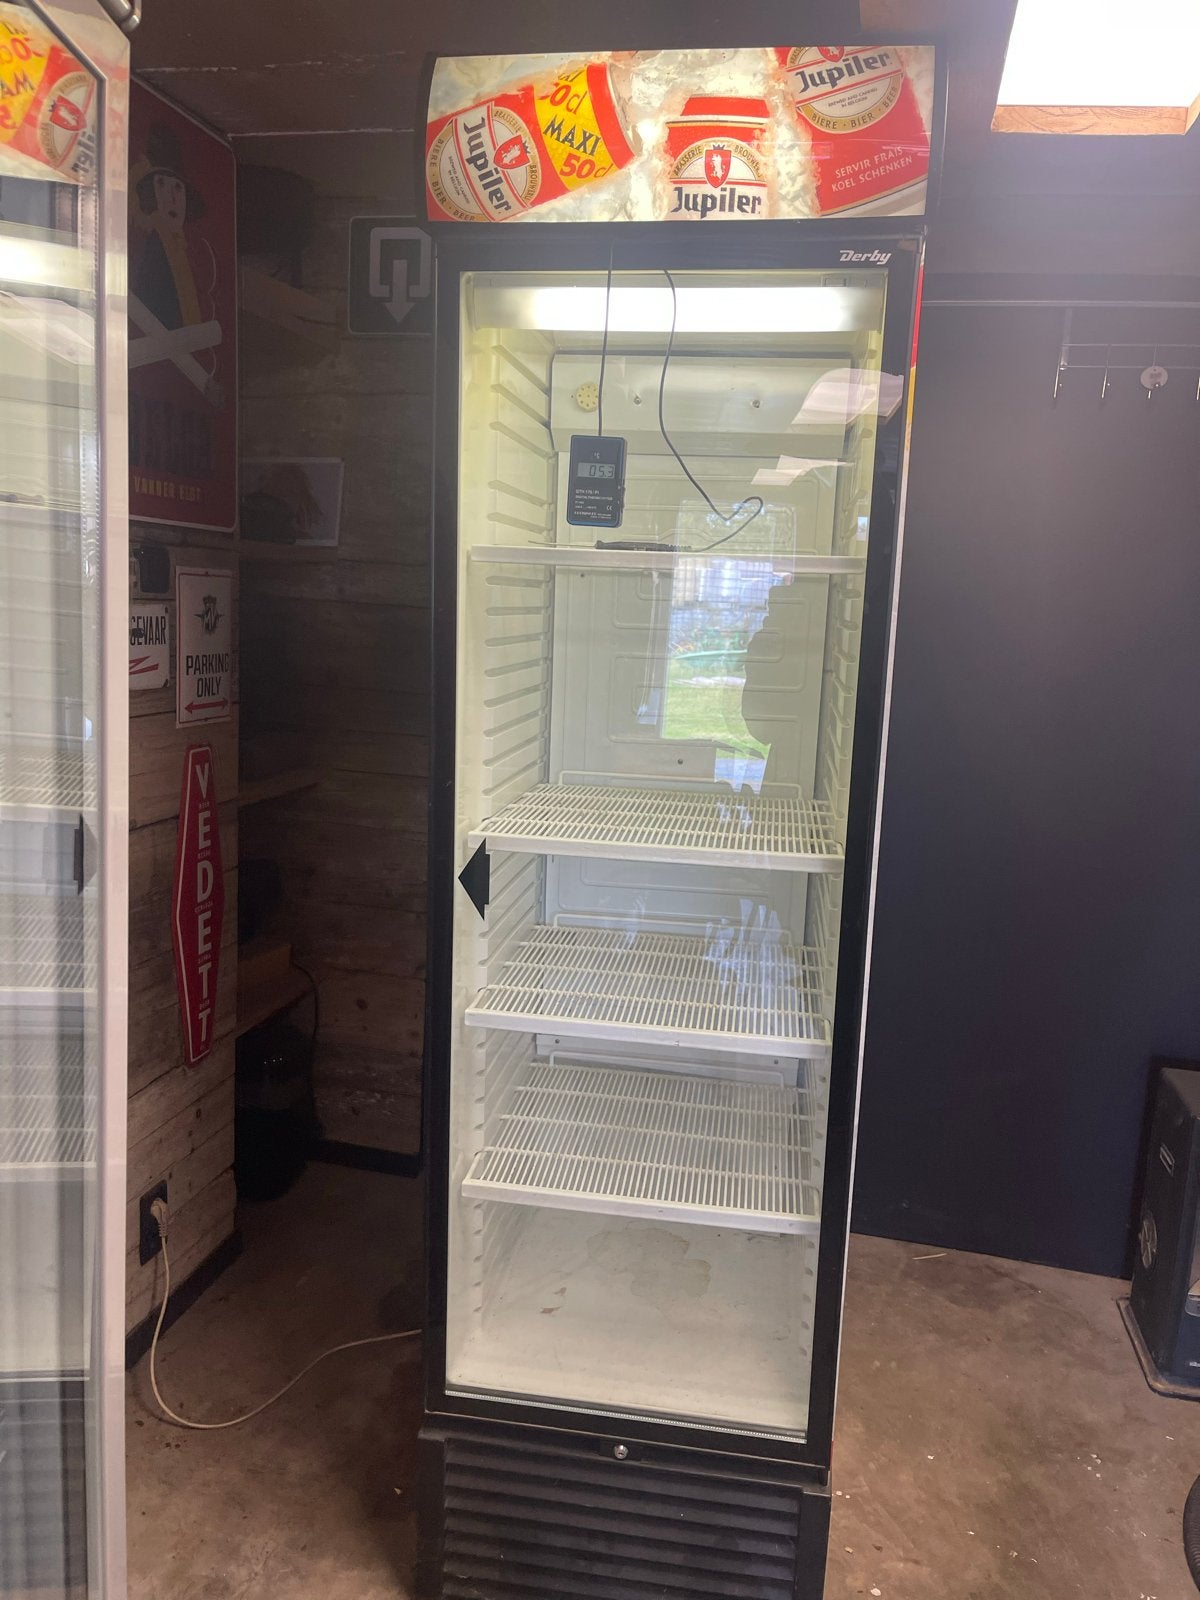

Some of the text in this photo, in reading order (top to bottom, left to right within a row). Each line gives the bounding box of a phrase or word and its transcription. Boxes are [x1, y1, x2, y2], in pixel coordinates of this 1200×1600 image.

[795, 52, 890, 93] Jupiler
[811, 86, 898, 129] BIERE BIER BEER
[542, 114, 601, 156] MAXI
[429, 138, 443, 167] BIERE
[464, 117, 512, 211] Jupiler
[673, 145, 702, 176] BRASSERIE
[835, 146, 903, 179] SERVIR FRAIS
[831, 155, 913, 192] KOEL SCHENKEN
[432, 181, 447, 204] BIER
[671, 187, 761, 219] Jupiler
[839, 249, 892, 265] Derby
[130, 615, 166, 646] GEVAAR
[186, 653, 229, 675] PARKING
[197, 676, 221, 697] ONLY
[195, 762, 214, 1042] VEDETT
